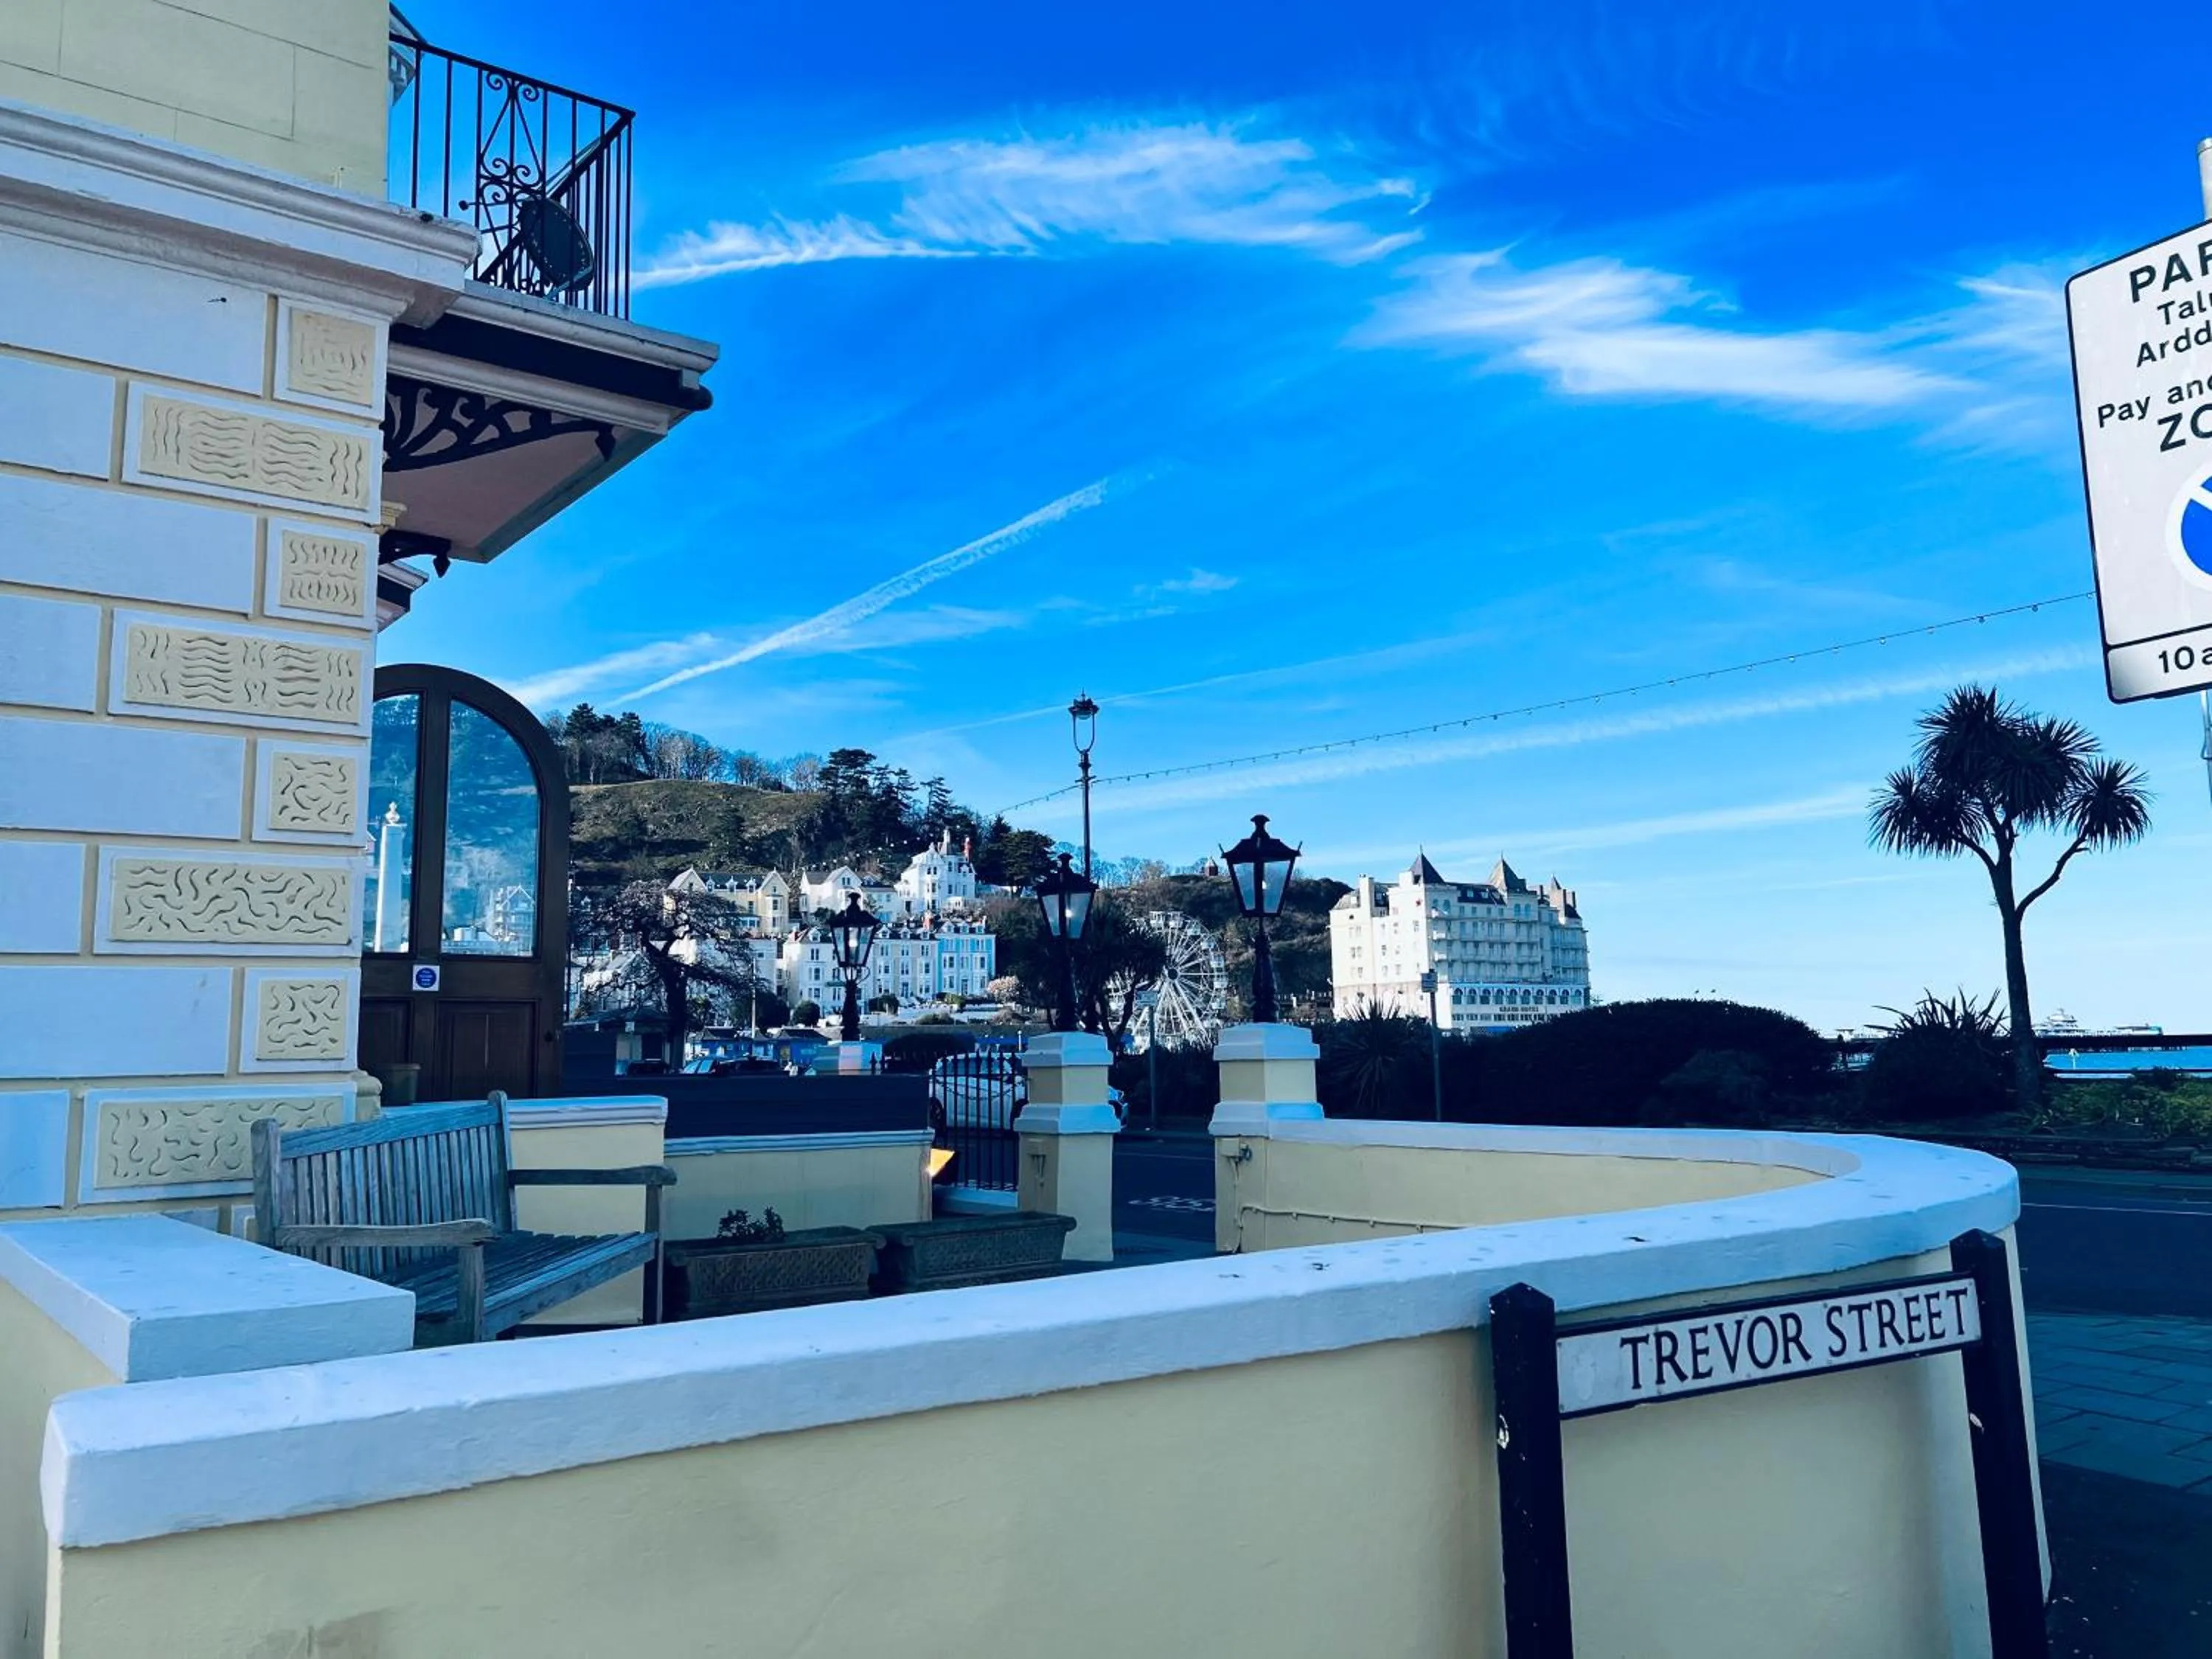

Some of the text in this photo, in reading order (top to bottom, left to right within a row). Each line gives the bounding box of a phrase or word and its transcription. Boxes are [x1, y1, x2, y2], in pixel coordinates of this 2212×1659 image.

[2157, 290, 2212, 325] Tal
[2098, 396, 2151, 428] Pay
[1619, 1286, 1969, 1390] TREVOR STREET
